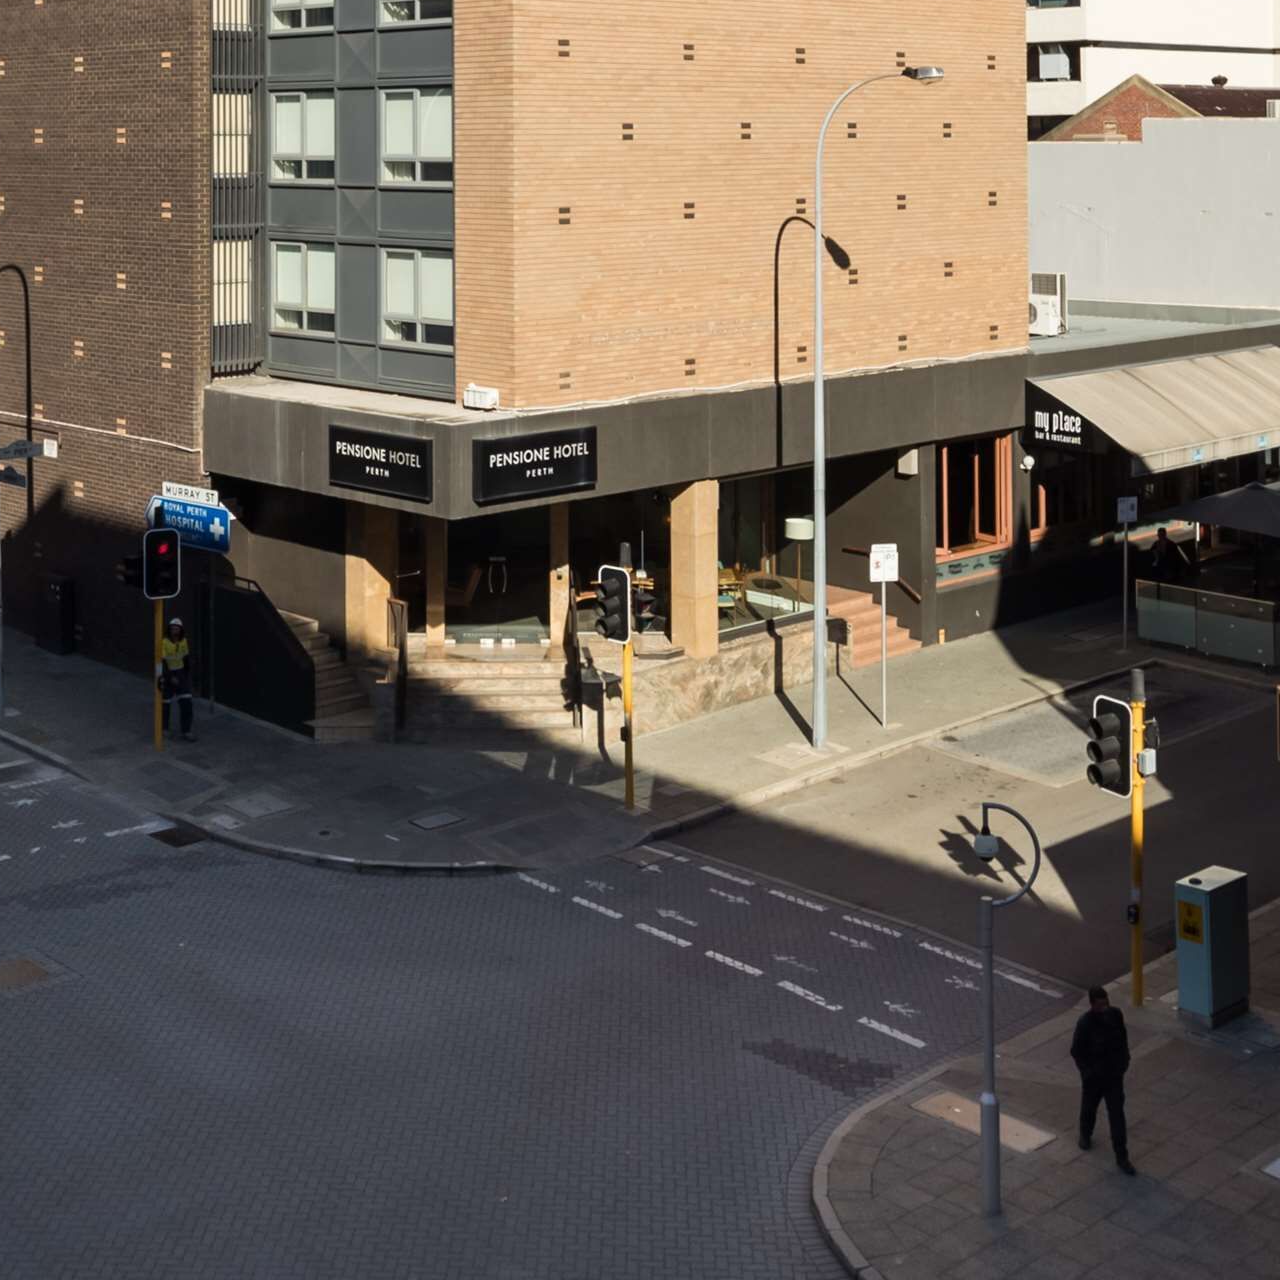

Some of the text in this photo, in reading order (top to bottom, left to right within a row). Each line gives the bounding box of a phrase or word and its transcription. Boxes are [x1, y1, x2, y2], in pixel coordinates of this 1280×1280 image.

[1034, 410, 1082, 434] my place
[335, 440, 422, 469] PENSIONE HOTEL
[489, 441, 589, 469] PENSIONE HOTEL
[365, 465, 390, 478] PERTH
[525, 466, 555, 479] PERTH
[165, 485, 215, 503] MURRAY ST
[163, 501, 208, 517] ROYAL PERTH
[165, 513, 205, 533] HOSPITAL
